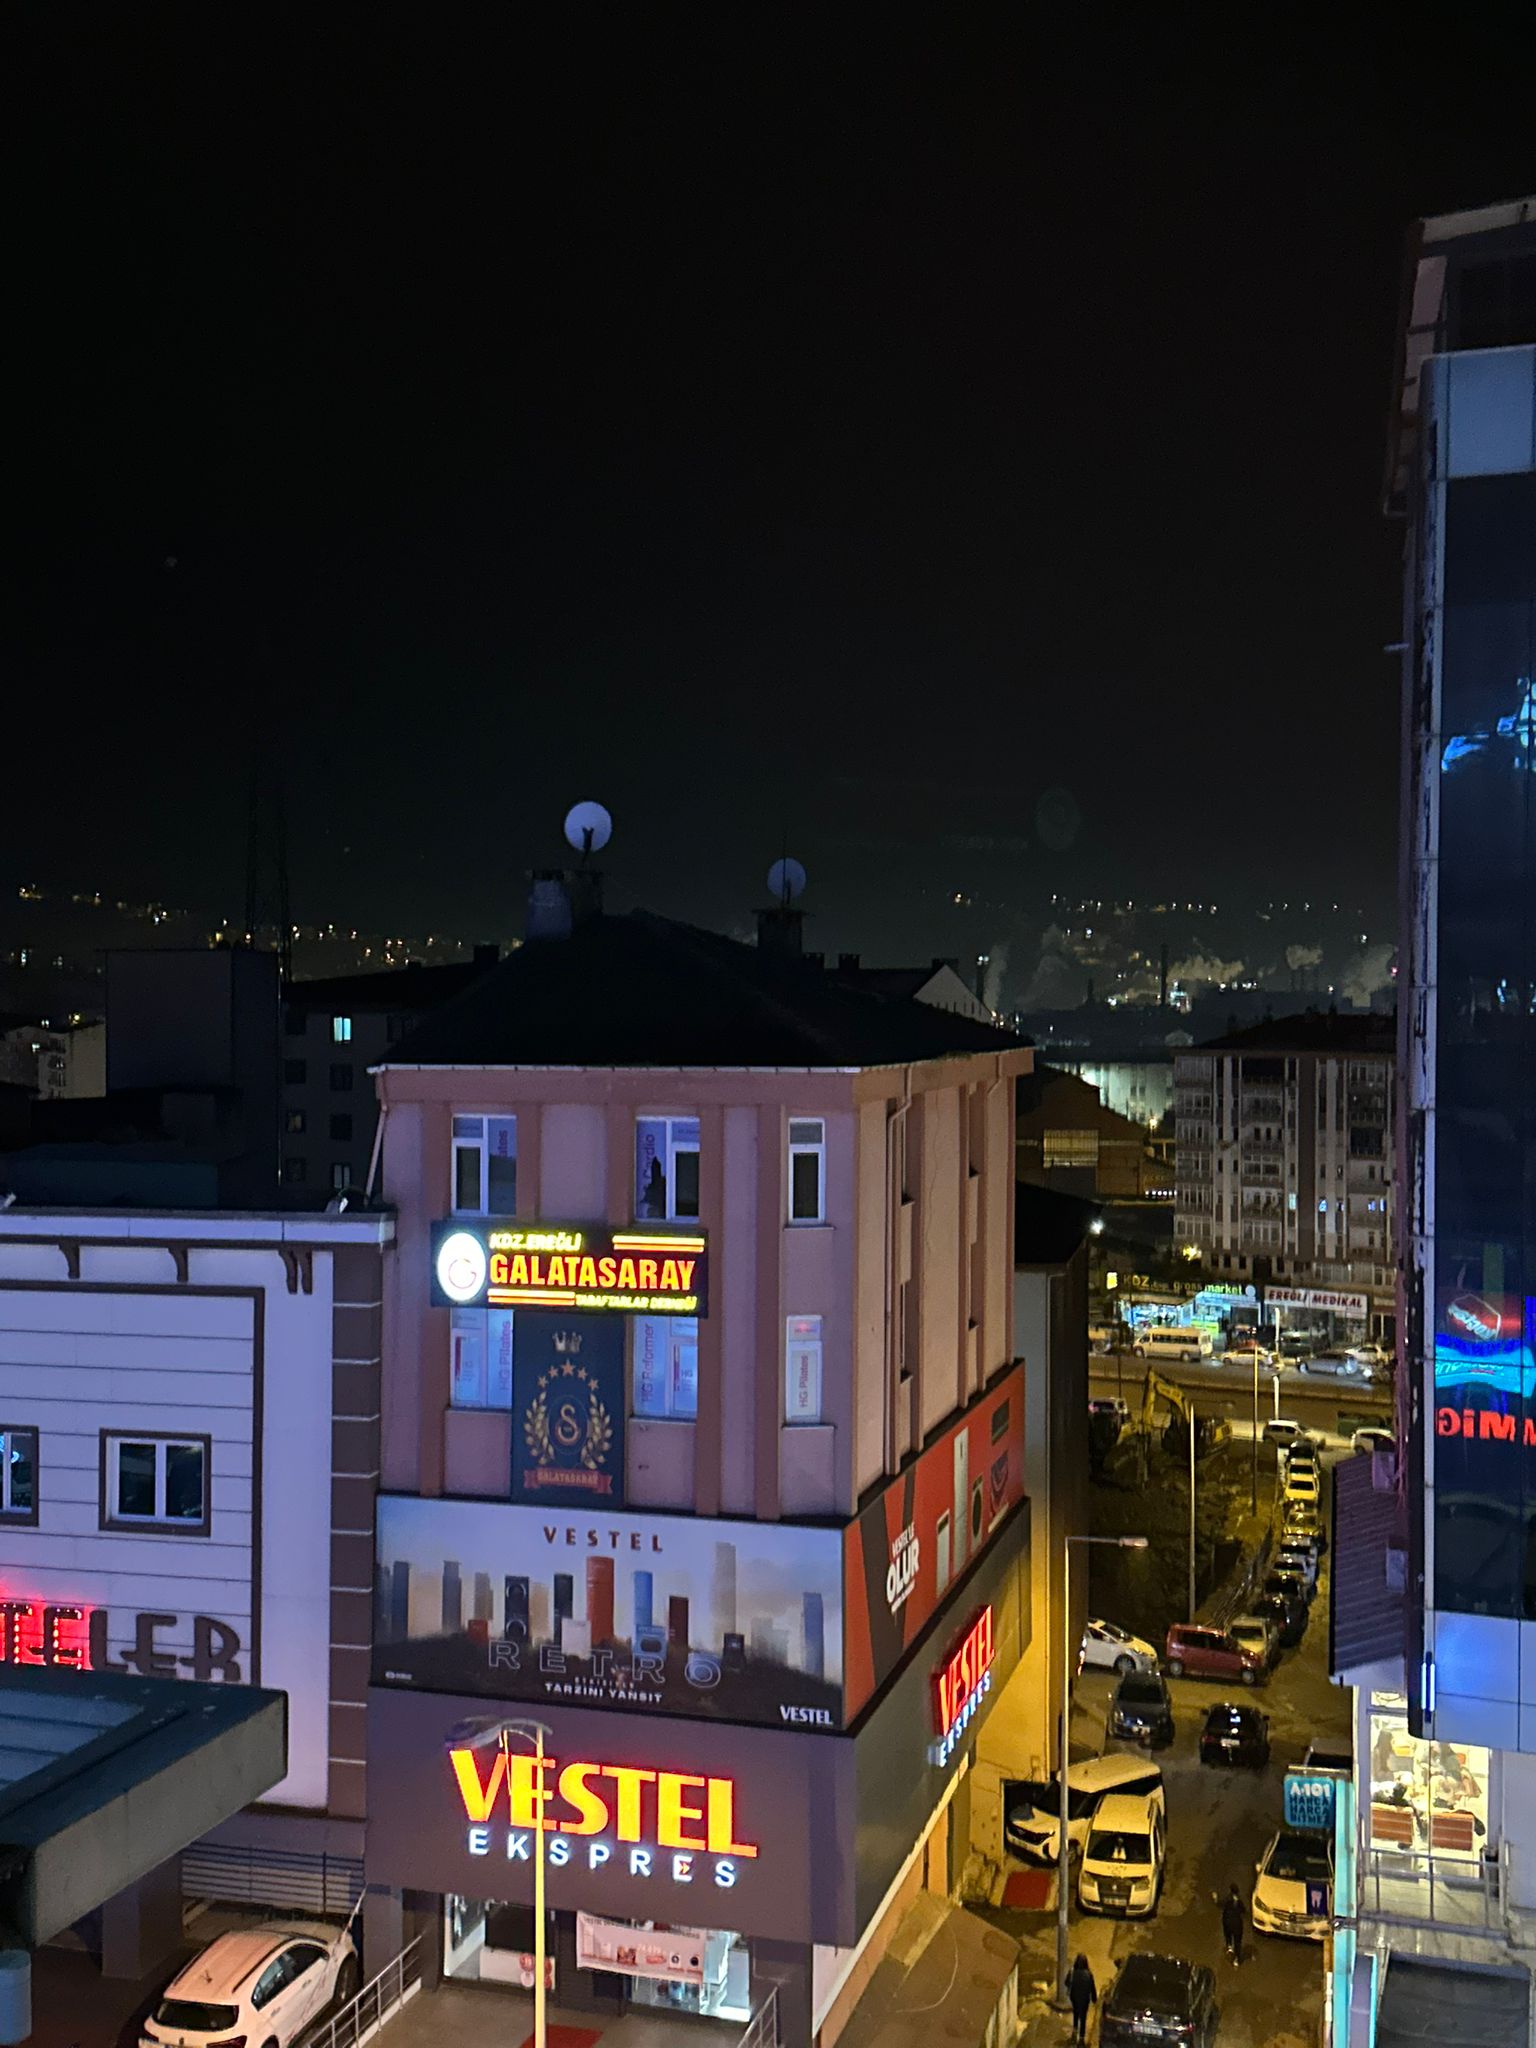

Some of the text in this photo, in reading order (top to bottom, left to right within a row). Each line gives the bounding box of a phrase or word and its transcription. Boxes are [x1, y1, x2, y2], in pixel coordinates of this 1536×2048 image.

[489, 1253, 695, 1291] GALATASARAY
[1204, 1282, 1242, 1295] market
[543, 1526, 664, 1553] VESTEL
[886, 1537, 919, 1603] OLUR
[939, 1605, 996, 1737] VESTEL
[779, 1704, 833, 1725] VESTEL
[449, 1748, 758, 1858] VESTEL
[467, 1828, 738, 1889] EKSPRES
